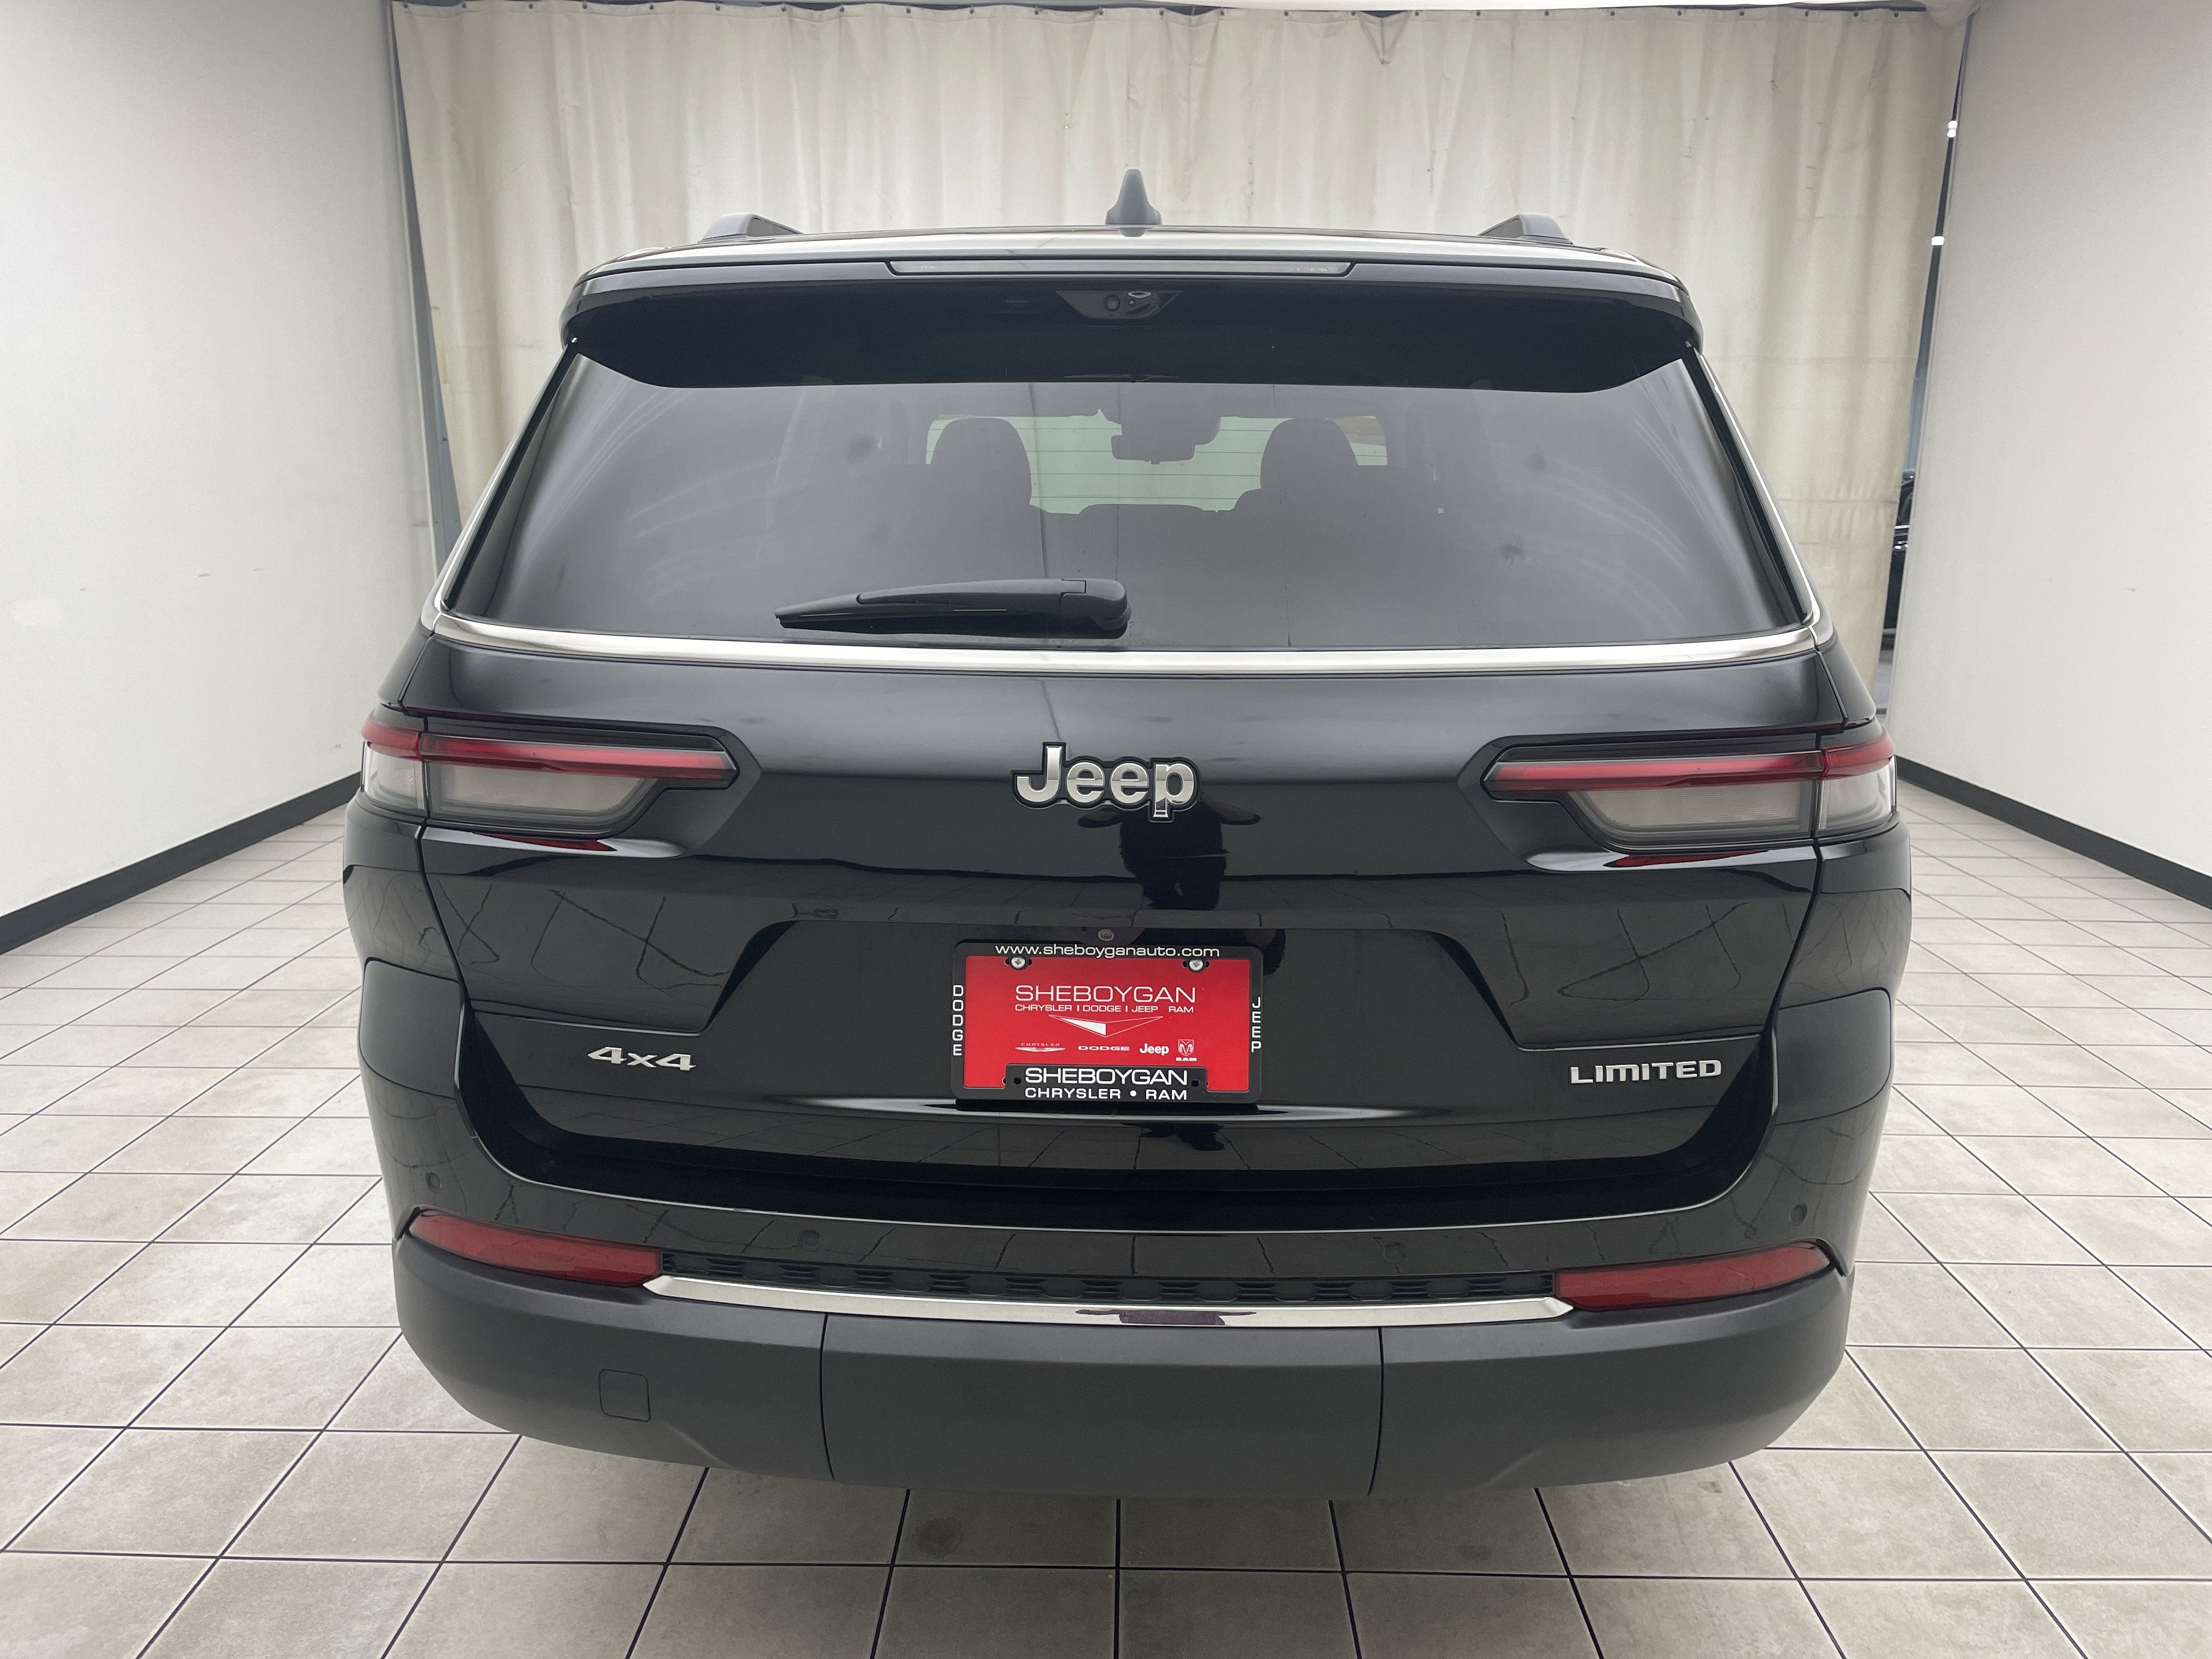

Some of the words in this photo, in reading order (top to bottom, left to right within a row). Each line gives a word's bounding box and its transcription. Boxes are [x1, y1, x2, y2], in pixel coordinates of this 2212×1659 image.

[1016, 746, 1194, 818] Jeep
[995, 944, 1220, 958] www.sheboyganauto.com
[1015, 985, 1196, 1003] SHEBOYGAN
[952, 985, 964, 1056] DODGE
[1251, 996, 1262, 1053] JEEP
[587, 1046, 697, 1071] 4x4
[1139, 1043, 1170, 1056] Jeep
[1025, 1067, 1187, 1085] SHEBOYGAN
[1570, 1059, 1722, 1084] LIMITED
[1025, 1087, 1121, 1099] CHRYSLER
[1146, 1089, 1187, 1101] RAM
